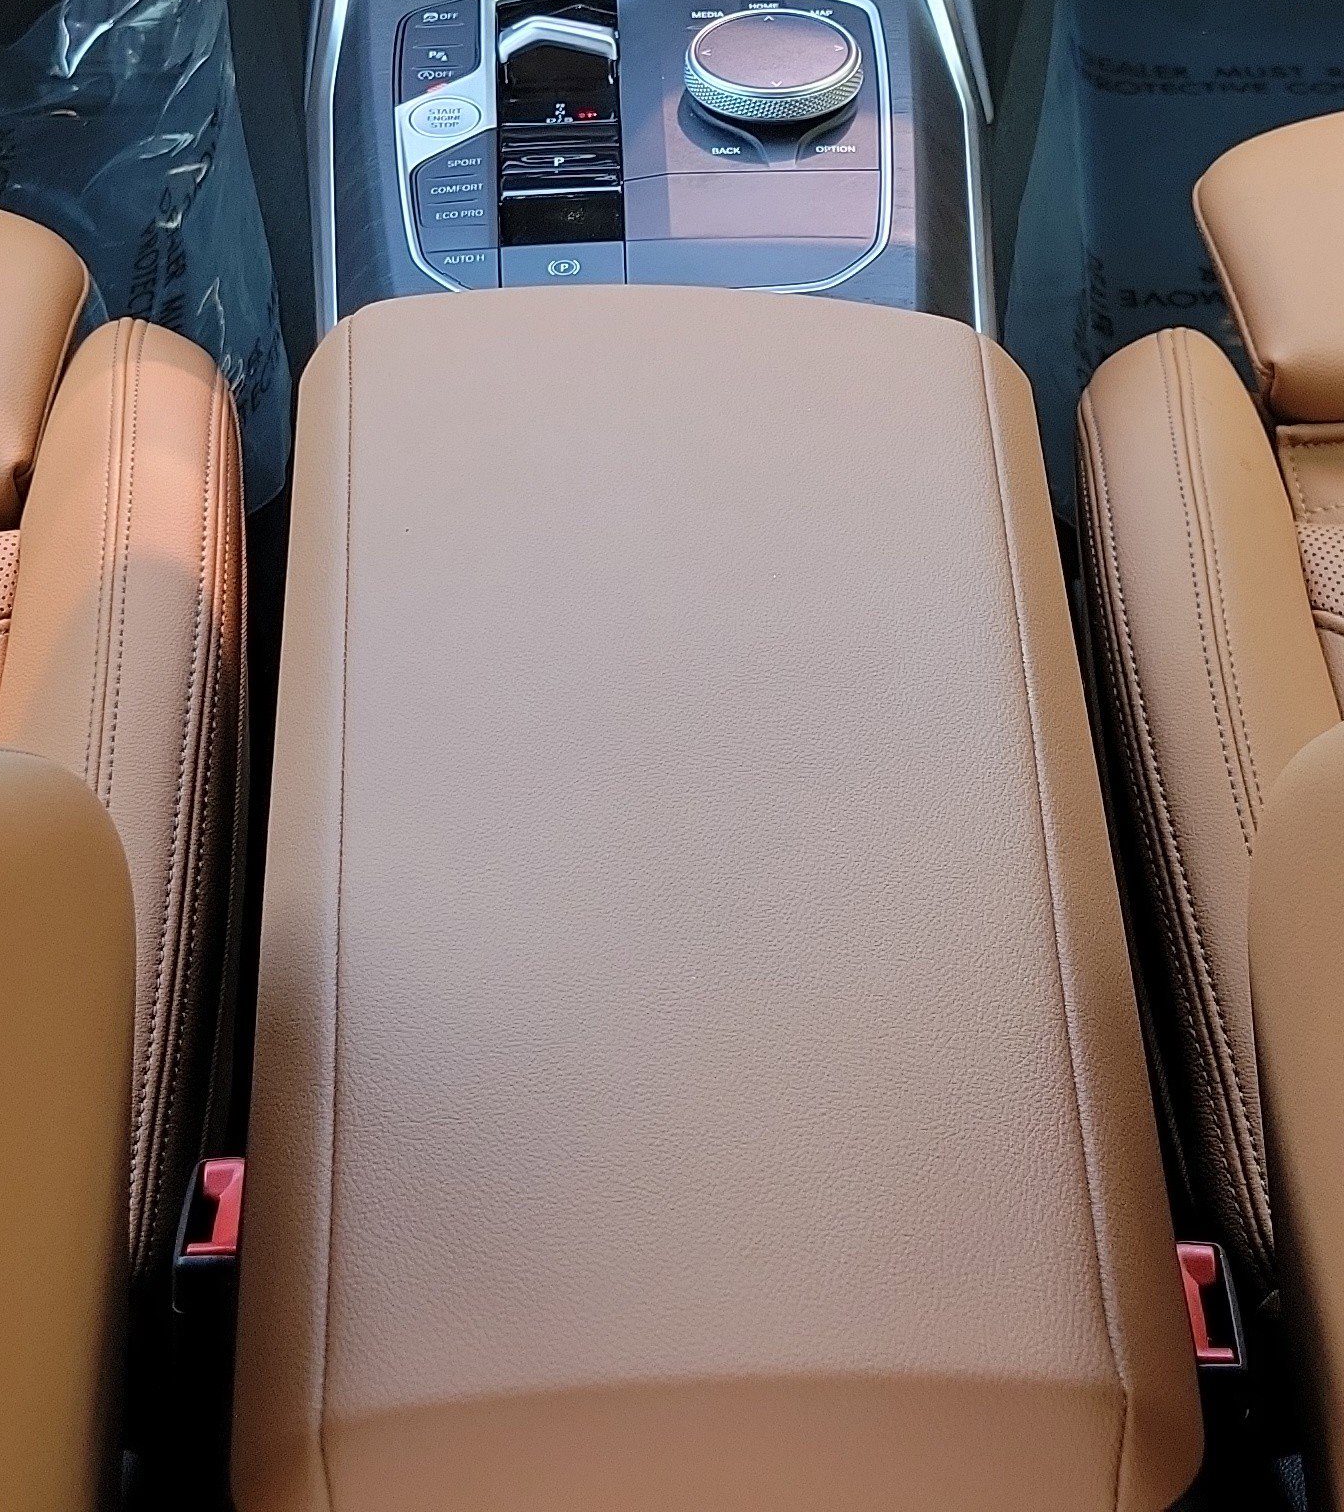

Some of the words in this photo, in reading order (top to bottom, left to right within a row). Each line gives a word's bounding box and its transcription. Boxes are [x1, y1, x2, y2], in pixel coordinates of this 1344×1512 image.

[439, 12, 459, 20] OFF
[691, 11, 724, 19] MEDIA
[435, 70, 454, 79] OFF
[428, 107, 462, 115] START
[430, 121, 459, 129] STOP
[711, 146, 741, 155] BACK
[815, 144, 857, 154] OPTION
[447, 157, 482, 168] SPORT
[430, 183, 483, 195] COMFORT
[435, 211, 459, 221] ECO
[460, 209, 484, 218] PRO
[443, 254, 475, 265] AUTO
[476, 254, 486, 263] H
